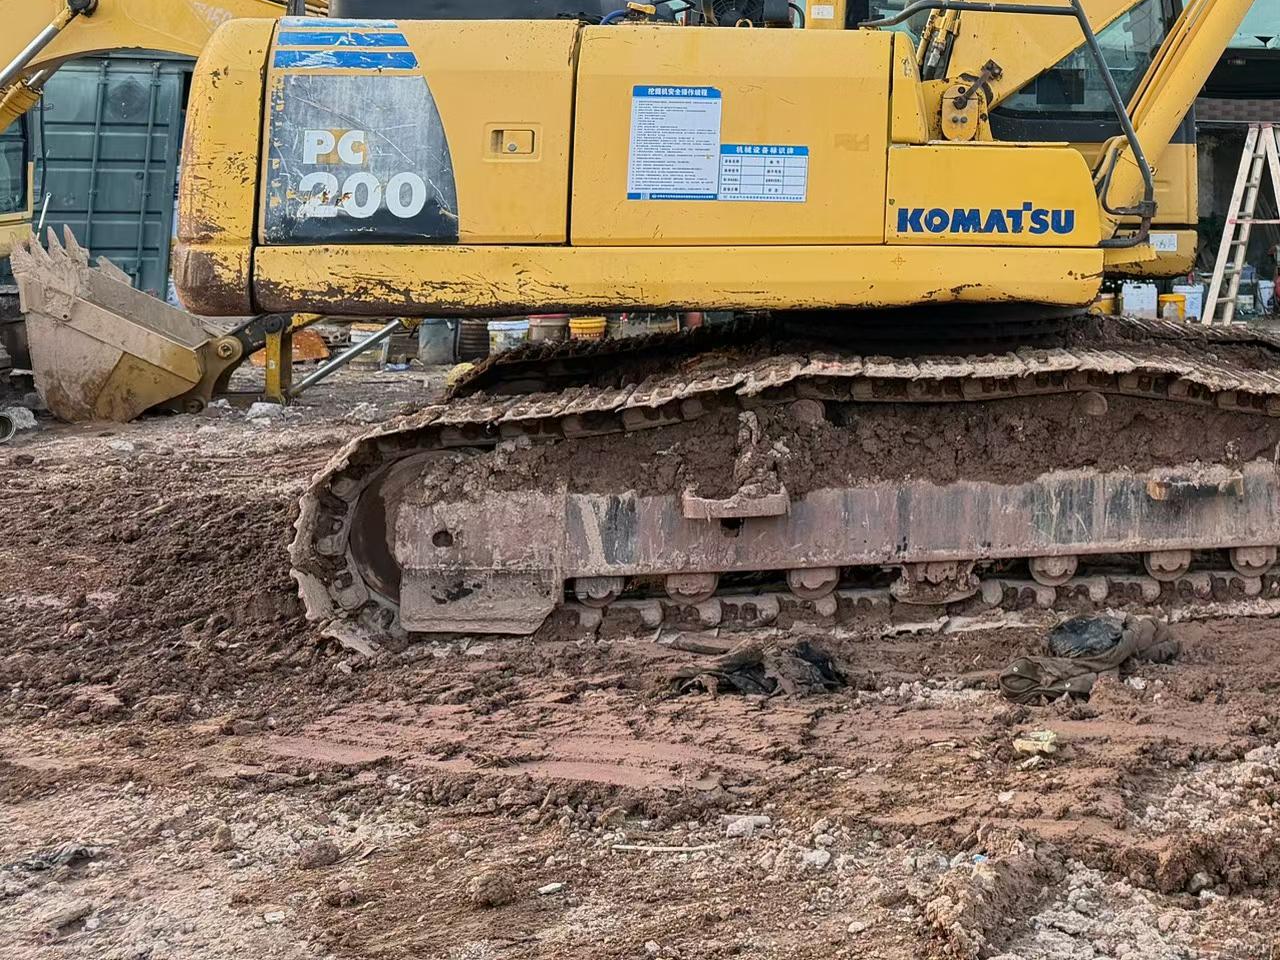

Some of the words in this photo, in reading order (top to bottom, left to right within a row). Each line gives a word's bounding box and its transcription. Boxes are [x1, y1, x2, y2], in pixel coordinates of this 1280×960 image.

[647, 87, 708, 97] 挖掘机安全操作规程
[302, 129, 365, 165] PC
[296, 171, 427, 219] 200
[896, 201, 1076, 234] KOMATSU
